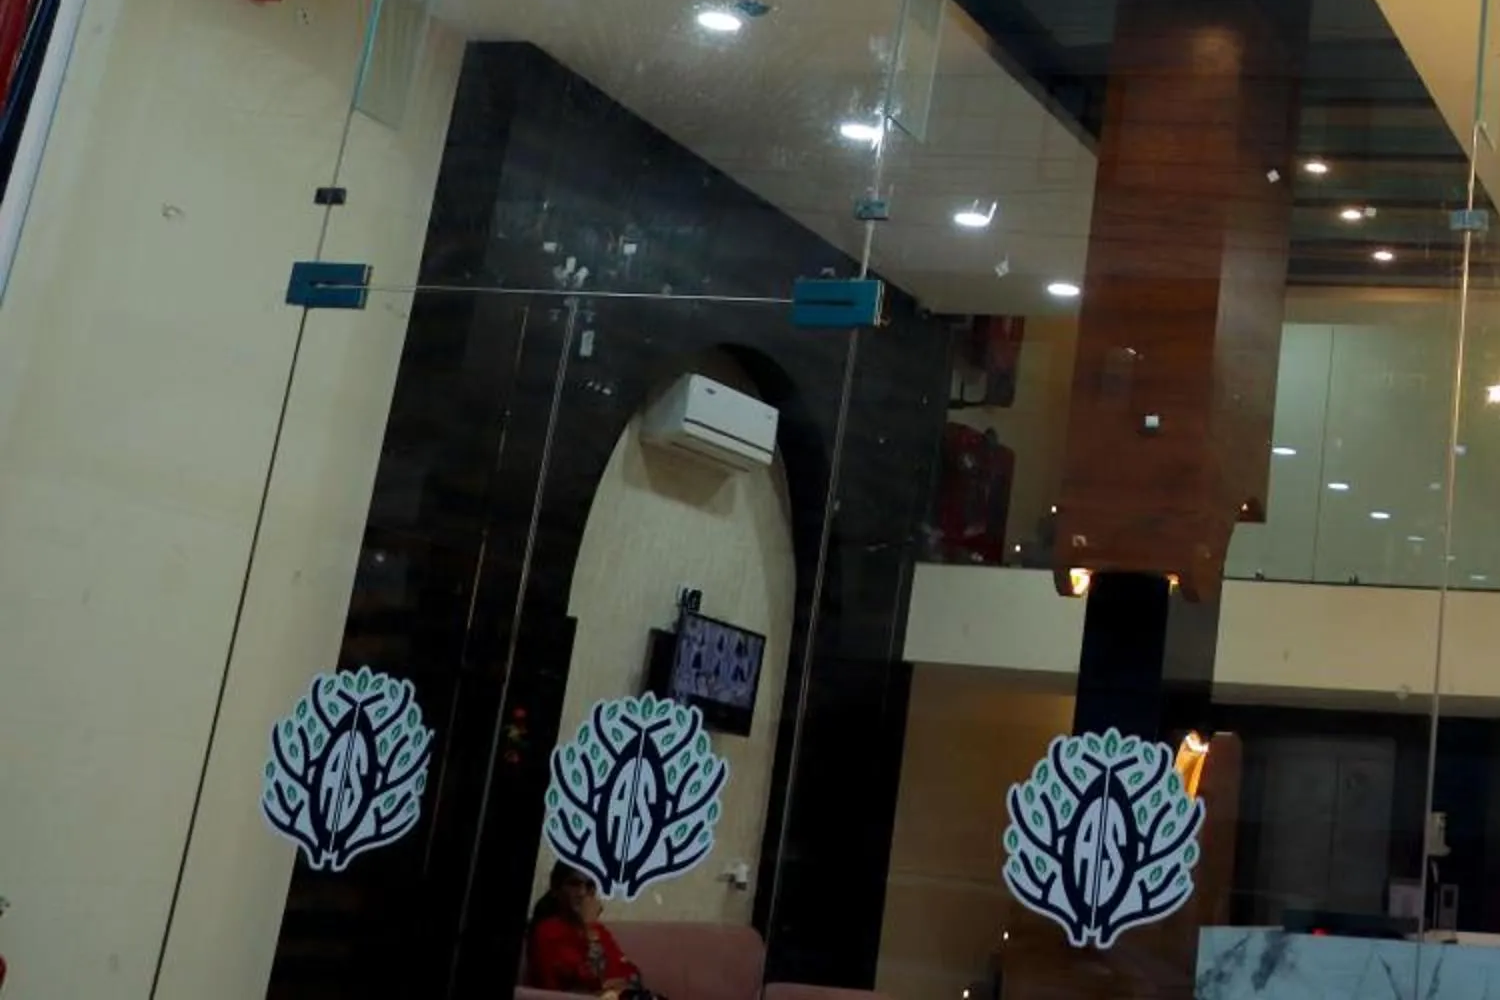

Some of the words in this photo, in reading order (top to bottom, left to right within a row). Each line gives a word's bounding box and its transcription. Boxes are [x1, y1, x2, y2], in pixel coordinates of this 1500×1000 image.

[319, 728, 369, 833] AS
[607, 756, 658, 862] AS
[1073, 796, 1127, 908] AS
